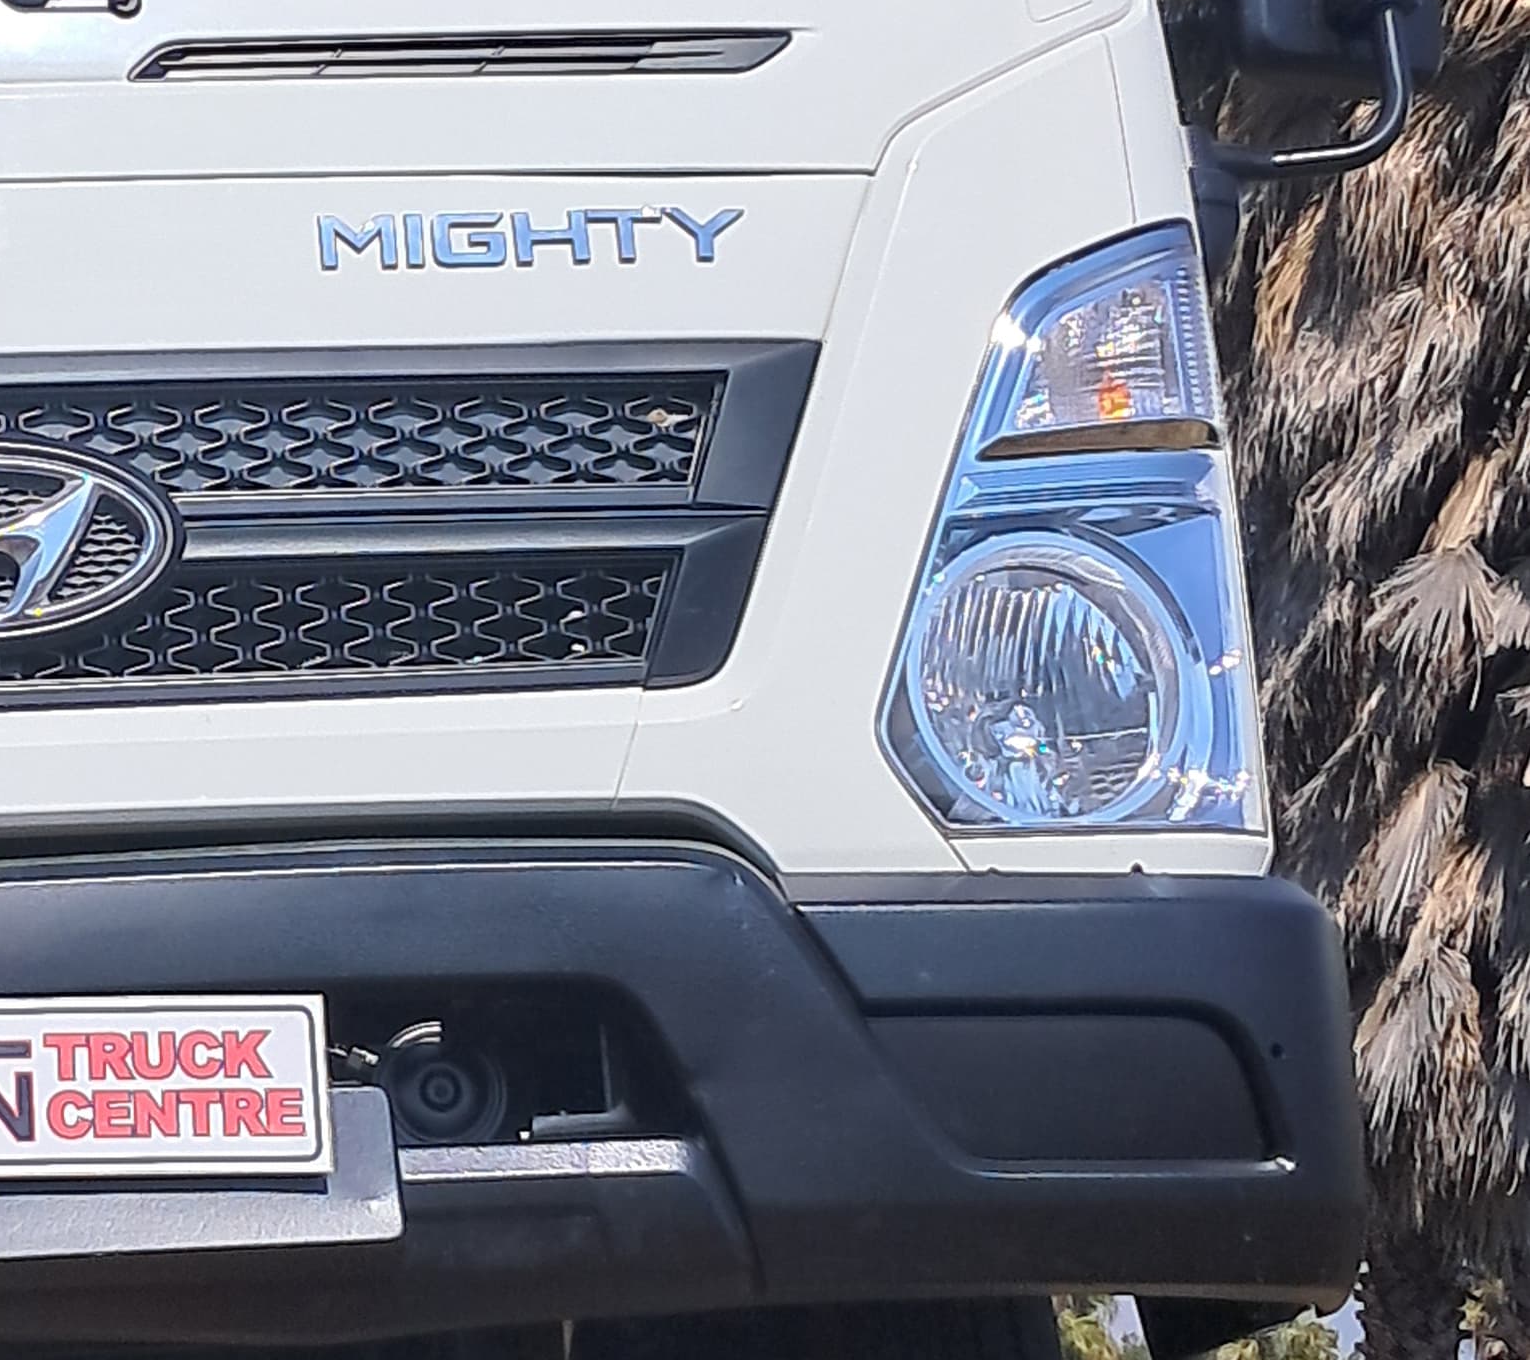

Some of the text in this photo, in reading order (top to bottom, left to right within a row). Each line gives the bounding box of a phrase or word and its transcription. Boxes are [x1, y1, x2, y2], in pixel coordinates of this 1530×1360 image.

[317, 204, 745, 271] MIGHTY
[43, 1029, 273, 1083] TRUCK
[45, 1087, 307, 1140] CENTRE
